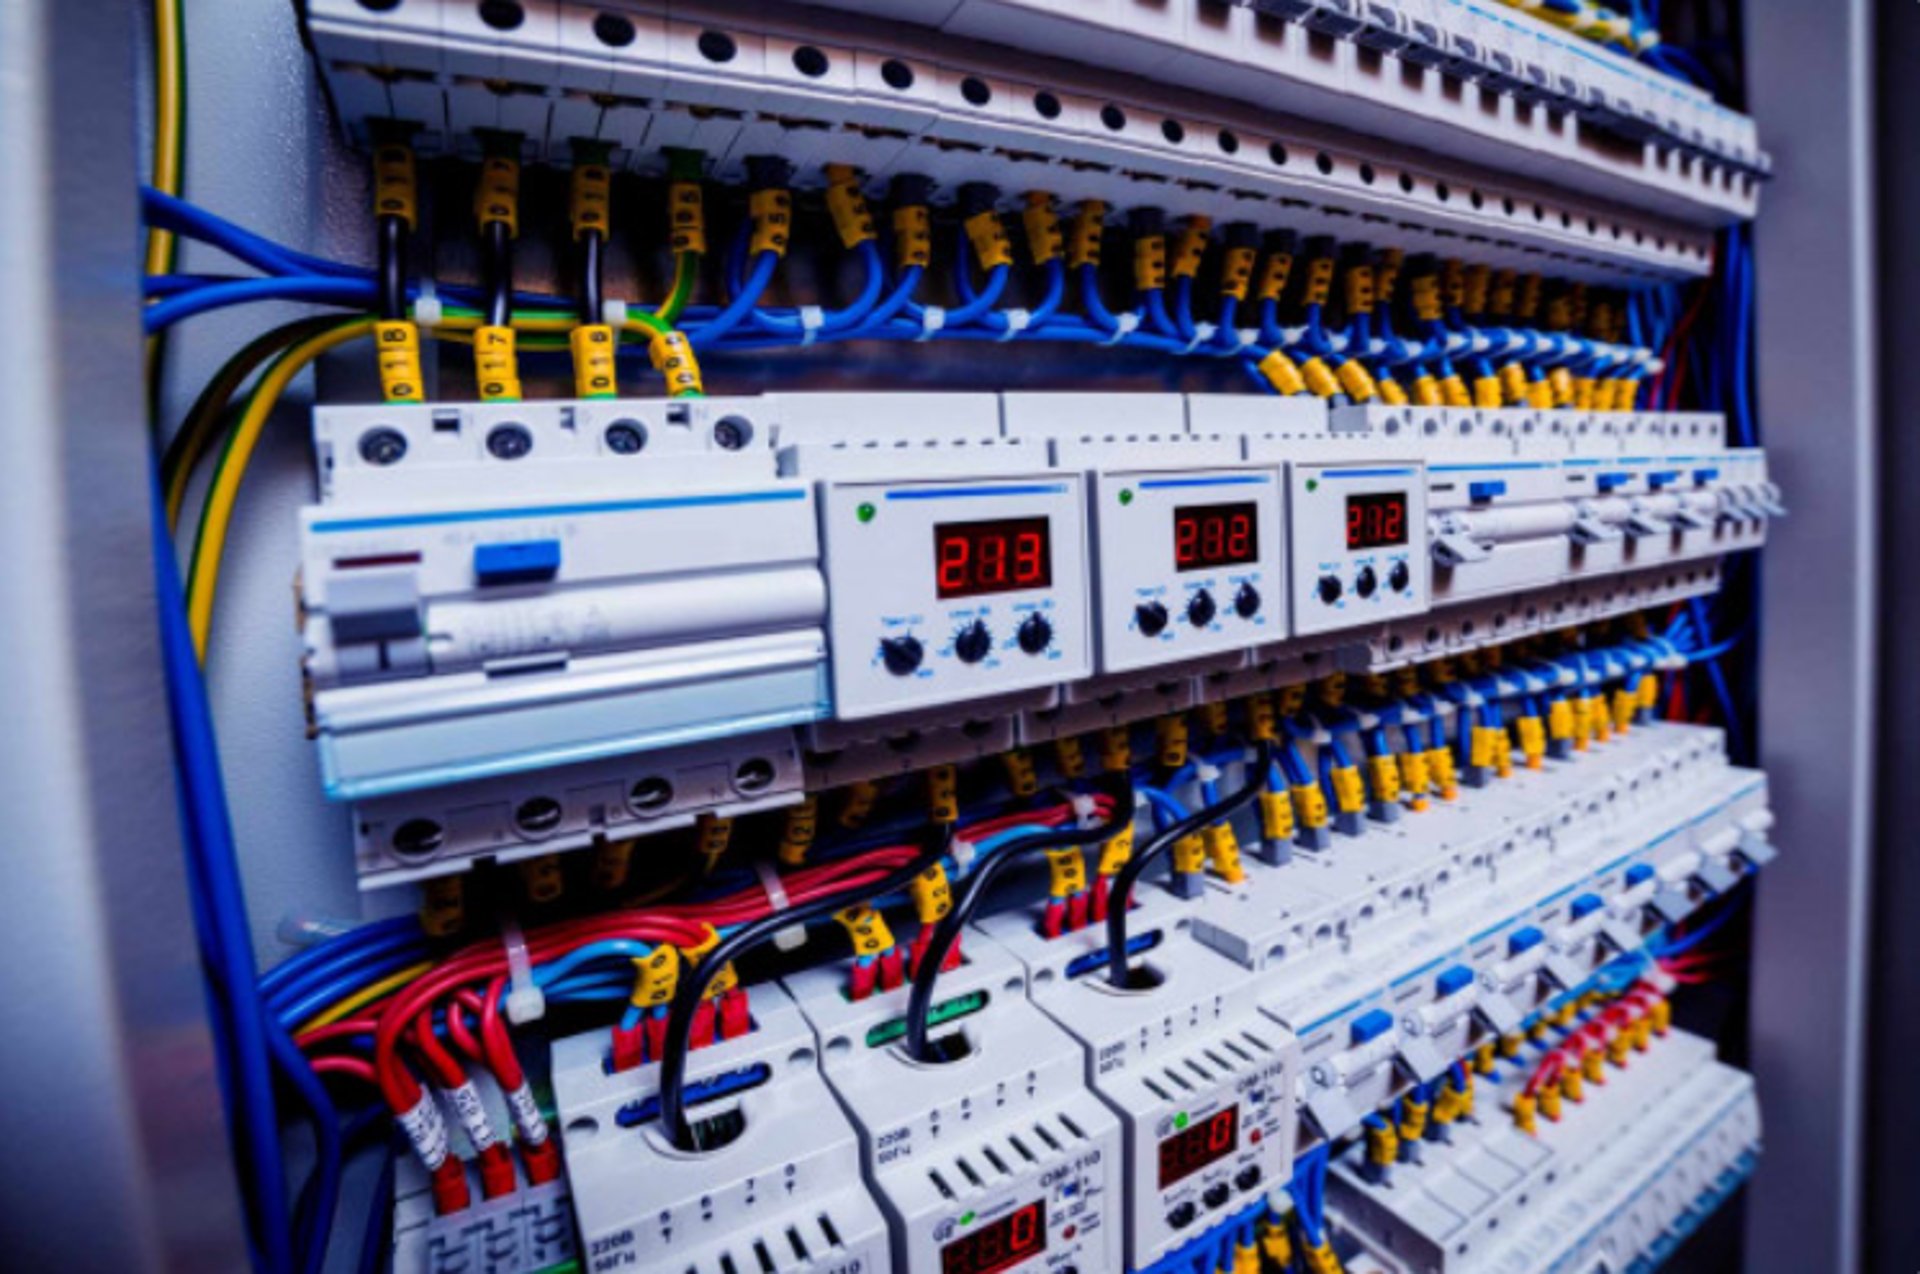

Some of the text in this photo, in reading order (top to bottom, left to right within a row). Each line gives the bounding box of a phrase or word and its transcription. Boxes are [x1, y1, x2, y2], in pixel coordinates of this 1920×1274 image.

[382, 328, 414, 397] 018
[483, 332, 508, 396] 017
[1175, 514, 1250, 562] 212
[1346, 501, 1404, 544] 212
[939, 533, 1041, 589] 213
[1208, 1110, 1232, 1151] 0
[1010, 1203, 1038, 1251] 0
